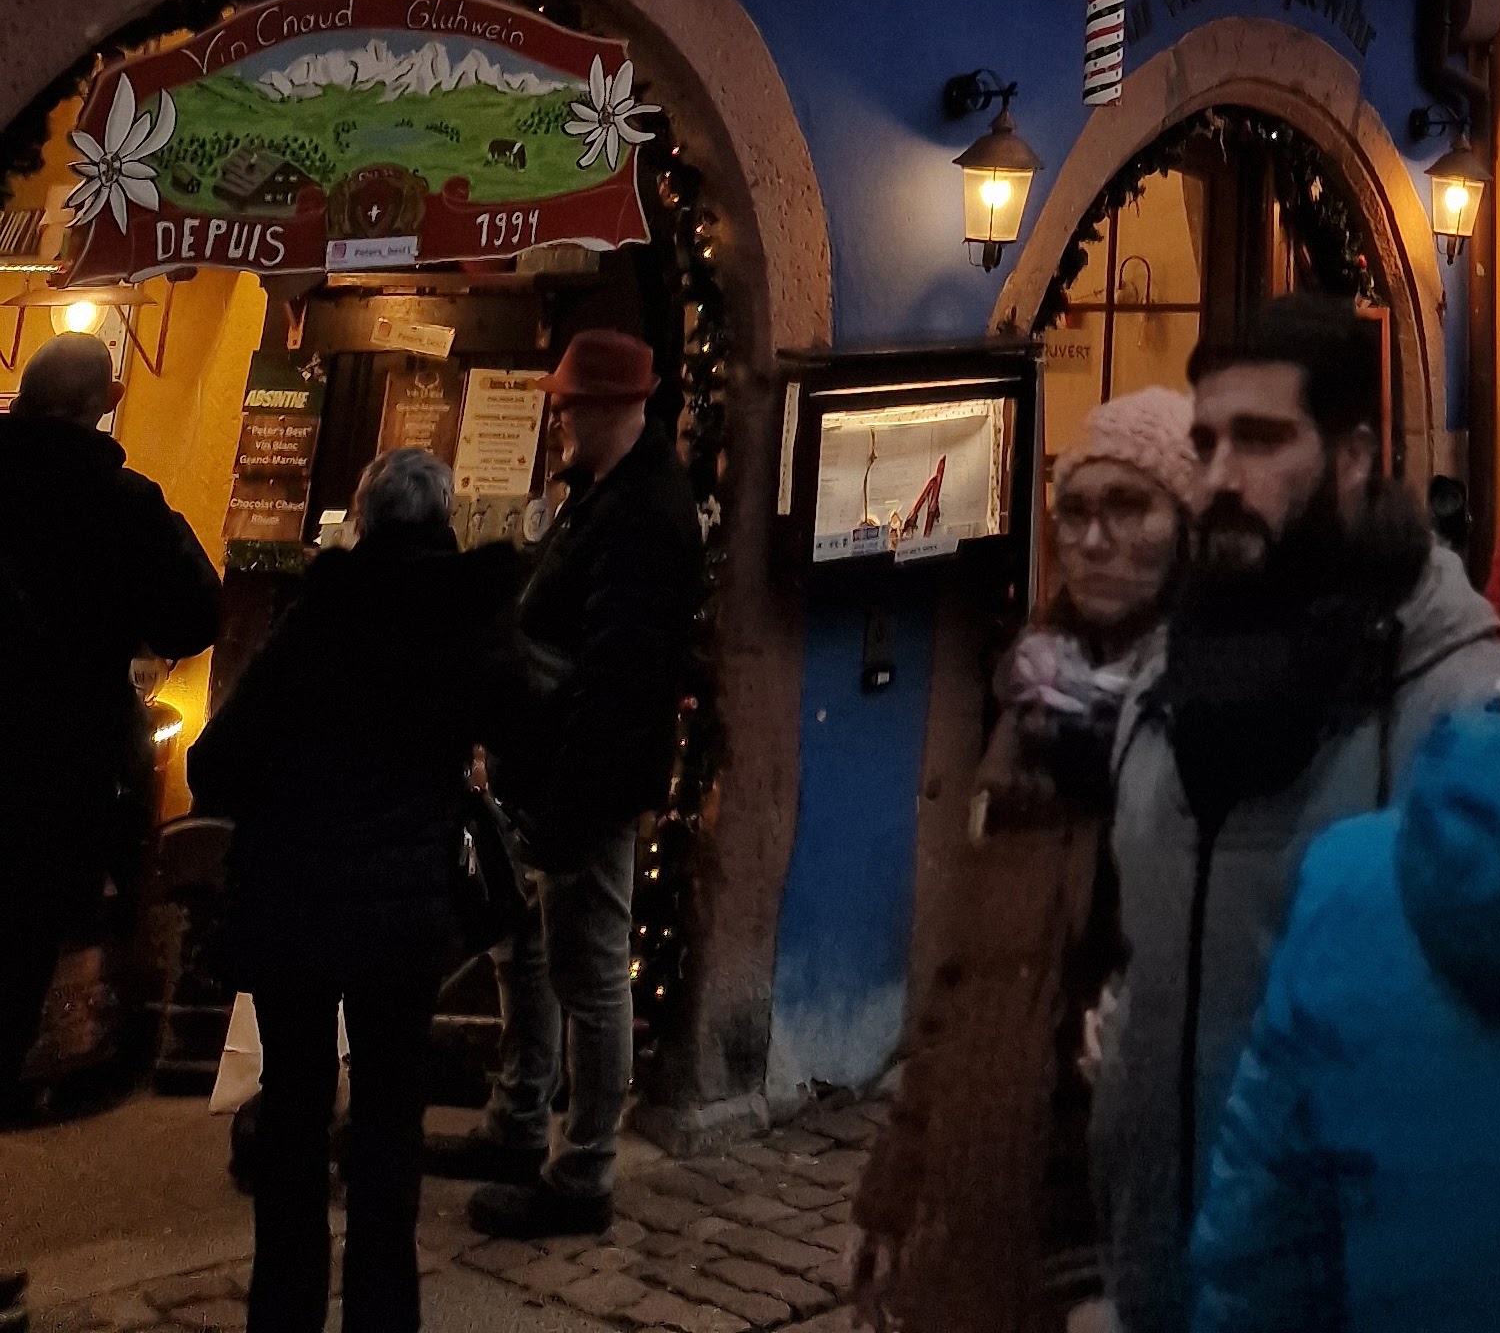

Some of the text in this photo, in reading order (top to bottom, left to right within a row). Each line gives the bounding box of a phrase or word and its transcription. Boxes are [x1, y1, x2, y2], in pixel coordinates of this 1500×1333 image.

[180, 29, 248, 75] Vin
[156, 218, 285, 267] DEPUIS
[243, 389, 310, 409] ABSINTHE
[272, 440, 299, 451] Blanc
[239, 454, 308, 466] Grand Marnier
[230, 497, 305, 511] Chocolat Chaud
